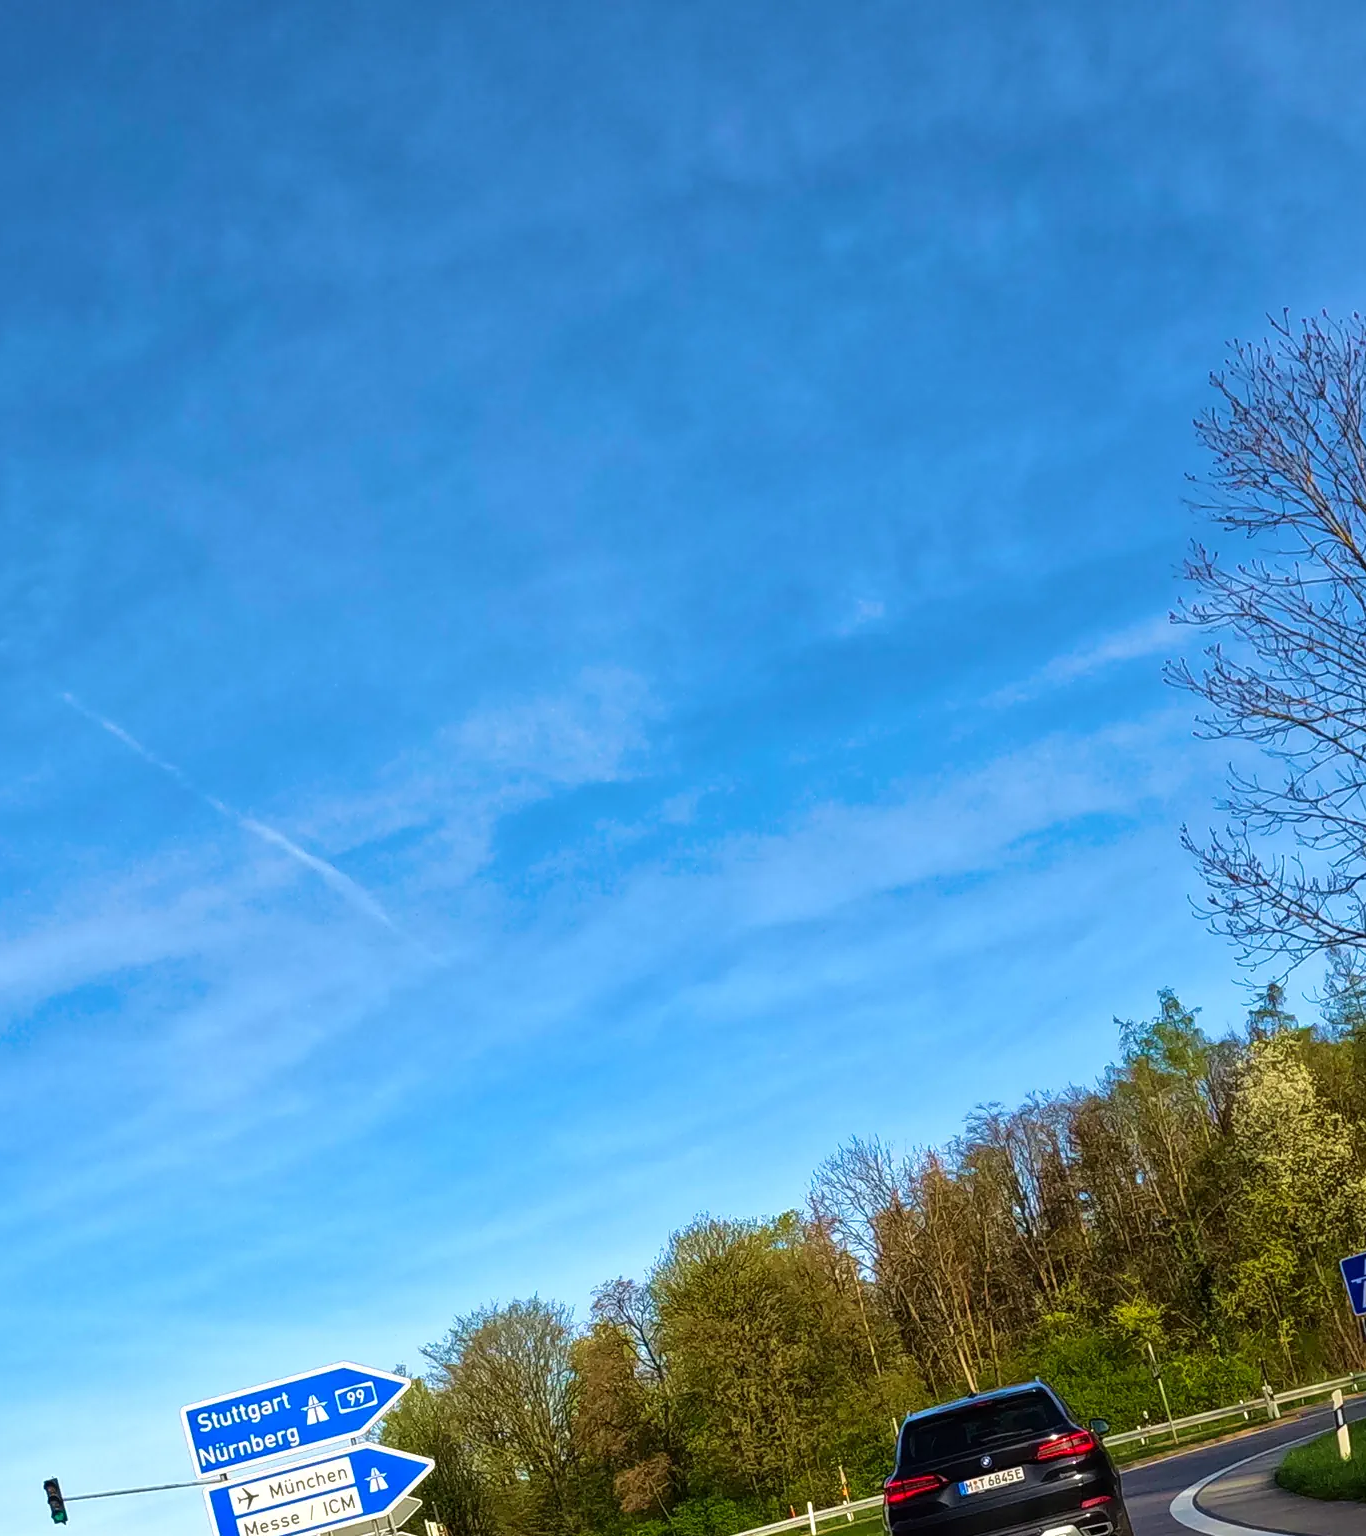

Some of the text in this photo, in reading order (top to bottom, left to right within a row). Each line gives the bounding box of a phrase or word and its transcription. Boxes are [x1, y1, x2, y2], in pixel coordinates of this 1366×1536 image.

[197, 1392, 292, 1432] Stuttgart
[346, 1389, 366, 1407] 99
[198, 1427, 300, 1467] Nürnberg
[268, 1468, 348, 1499] München
[323, 1494, 356, 1516] ICM
